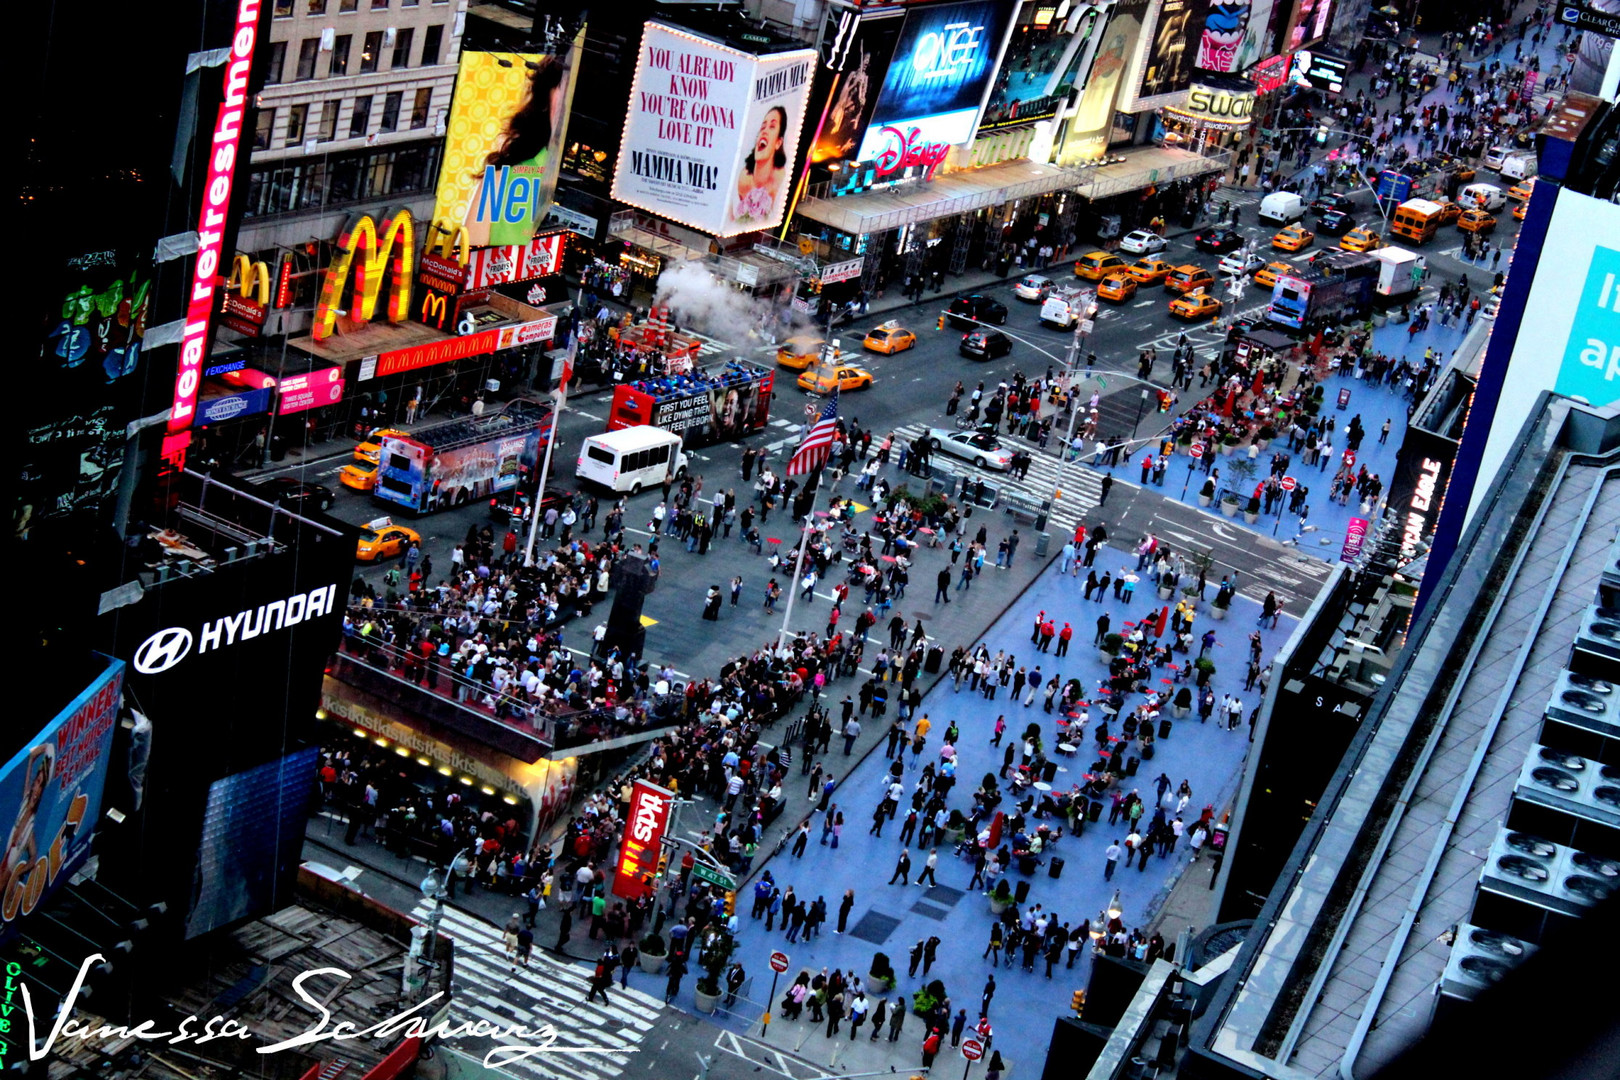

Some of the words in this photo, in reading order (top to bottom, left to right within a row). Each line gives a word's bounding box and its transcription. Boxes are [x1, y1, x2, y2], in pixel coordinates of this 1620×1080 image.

[649, 46, 674, 71] YOU
[677, 53, 737, 82] ALREADY
[914, 26, 984, 71] ONCE
[670, 74, 711, 100] KNOW
[754, 70, 787, 101] MAMMA
[788, 62, 809, 89] MIA!
[641, 92, 687, 120] YOU'RE
[691, 102, 735, 130] GONNA
[658, 119, 692, 144] LOVE
[696, 126, 714, 148] IT!
[630, 150, 682, 184] MAMMA
[686, 162, 718, 190] MIA!
[422, 257, 462, 277] McDonald's
[228, 299, 262, 318] cDonald's
[174, 320, 206, 420] real
[210, 360, 245, 374] EXCHANGE
[657, 412, 672, 425] LIKE
[673, 408, 694, 421] DYING
[694, 404, 711, 416] THEN
[660, 400, 679, 414] FIRST
[679, 397, 693, 410] YOU
[693, 394, 709, 407] FEEL
[671, 419, 687, 432] FEEL
[687, 414, 713, 427] REBORN
[1411, 457, 1442, 512] EAGLE
[199, 584, 336, 654] HYUNDAI
[57, 672, 121, 754] WINNER!
[634, 793, 663, 842] tkts
[700, 868, 706, 876] W
[708, 873, 717, 881] 47
[0, 962, 21, 1033] OLIVE
